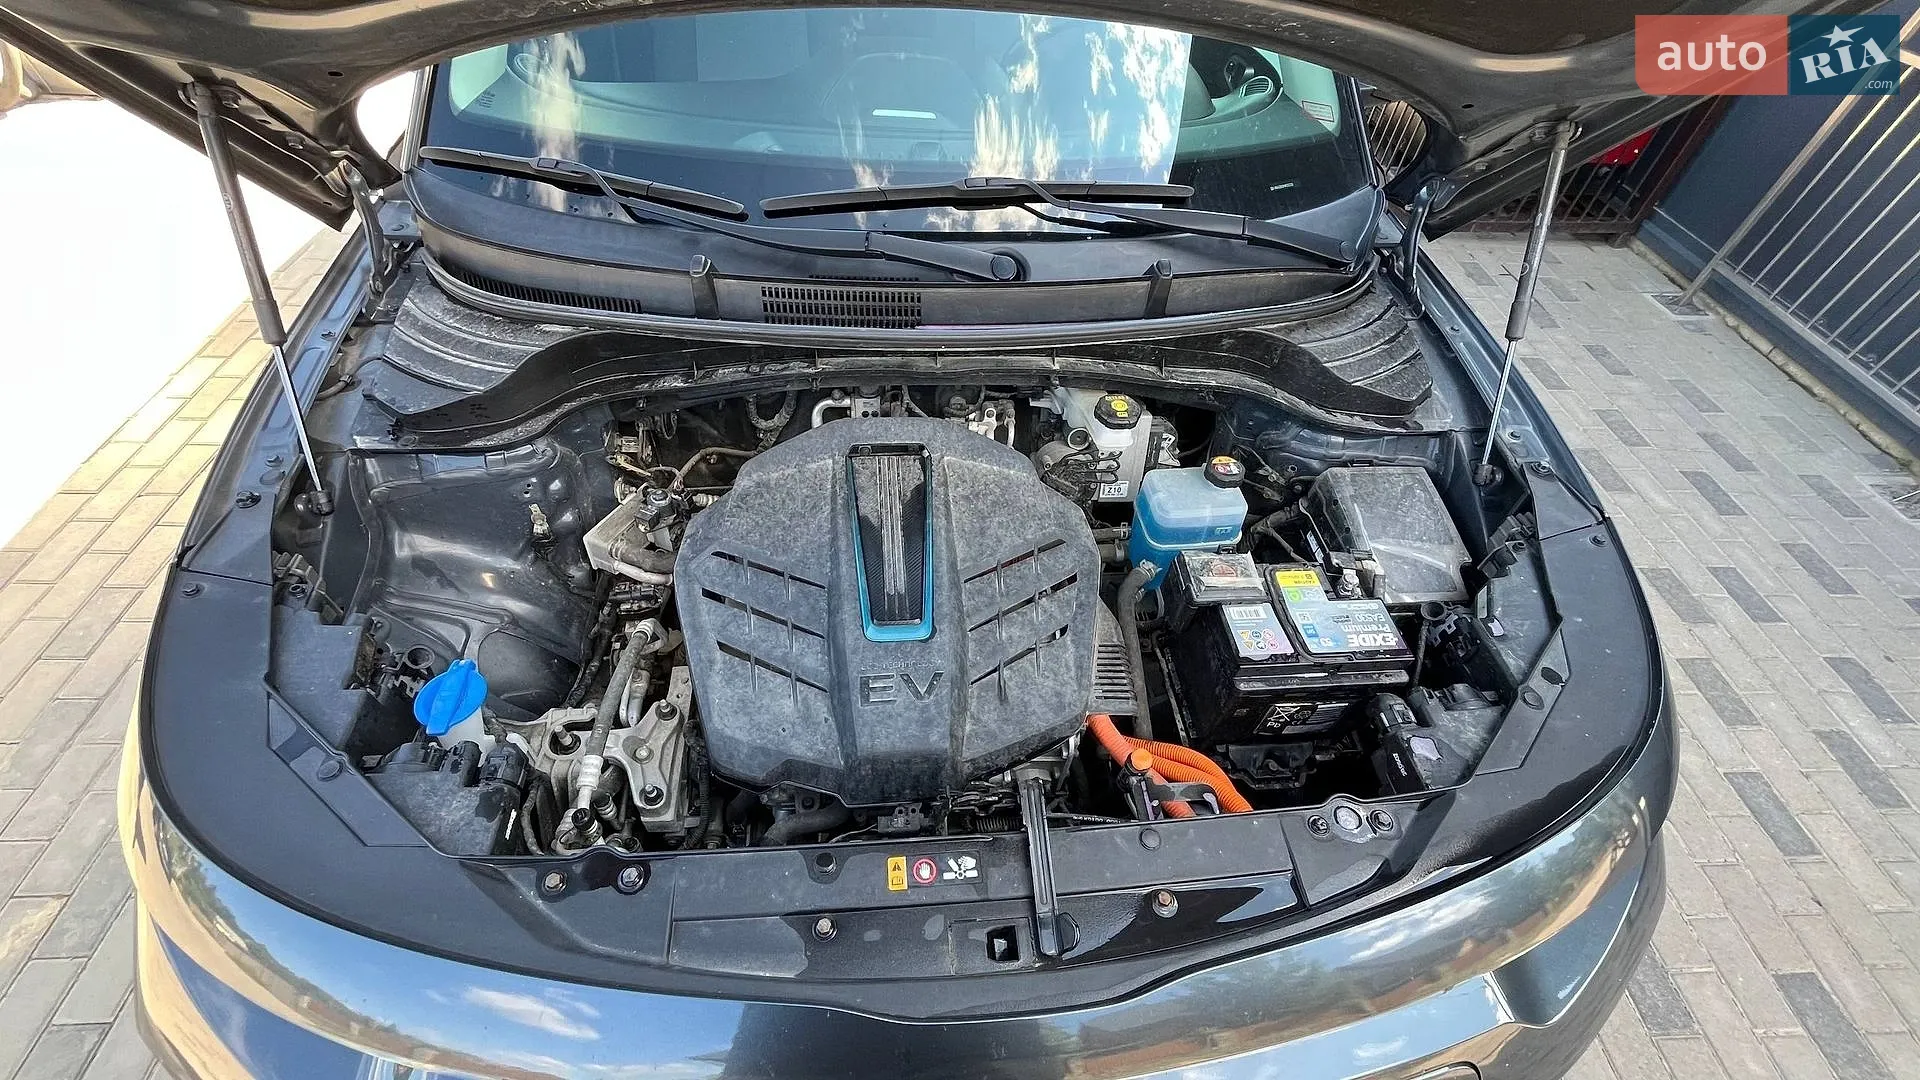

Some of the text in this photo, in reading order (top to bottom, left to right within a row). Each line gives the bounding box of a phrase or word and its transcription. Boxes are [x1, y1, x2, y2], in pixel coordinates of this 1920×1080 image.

[1355, 613, 1385, 622] EA530
[1341, 623, 1391, 633] Premium
[1346, 633, 1397, 647] EXIDE
[859, 670, 945, 708] EV
